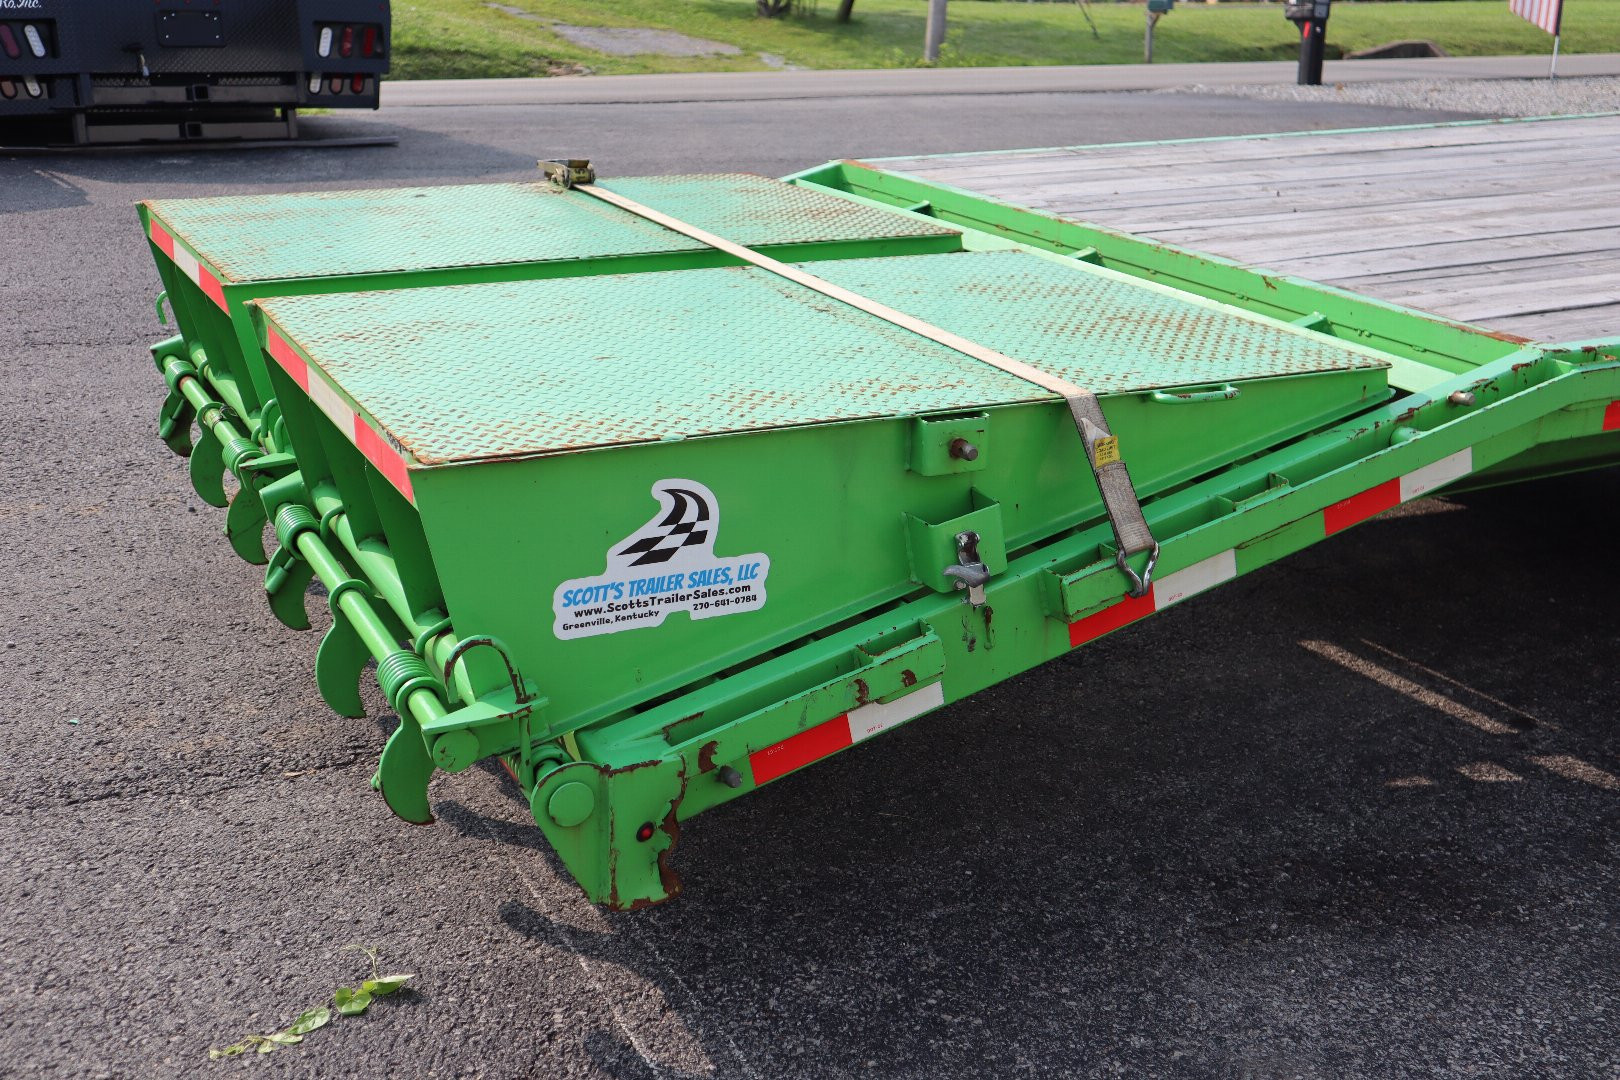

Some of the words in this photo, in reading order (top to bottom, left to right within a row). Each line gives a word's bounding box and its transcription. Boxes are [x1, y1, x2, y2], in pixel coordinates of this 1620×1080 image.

[562, 581, 625, 608] SCOTT'S
[628, 573, 685, 598] TRAILER
[687, 566, 734, 589] SALES,
[737, 562, 761, 582] LLC
[574, 584, 751, 618] www.ScottsTrailerSales.com
[692, 594, 757, 611] 270-641-0784
[562, 617, 614, 631] Greenville,
[614, 609, 660, 623] Kentucky
